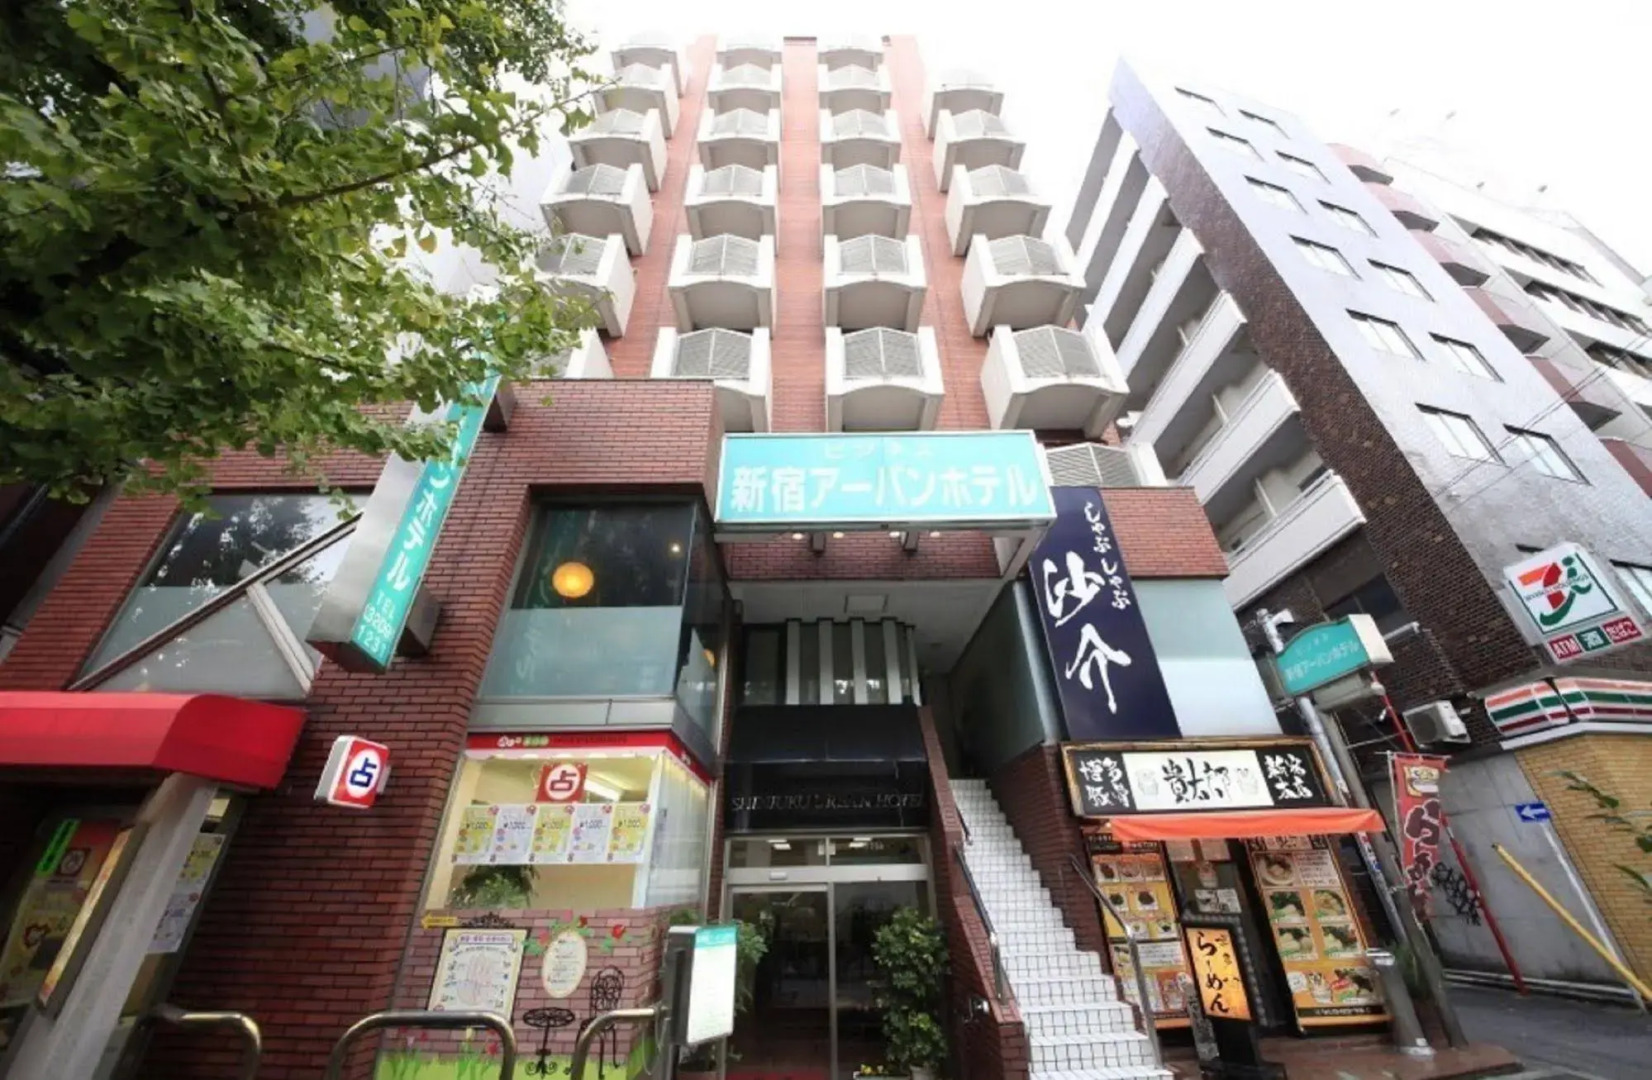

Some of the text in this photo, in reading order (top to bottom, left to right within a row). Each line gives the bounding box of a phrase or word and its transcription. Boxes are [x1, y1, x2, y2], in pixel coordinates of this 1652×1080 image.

[730, 464, 1039, 513] 新宿アーバンホテル
[1551, 637, 1582, 658] ATM
[350, 757, 377, 788] 占
[550, 769, 577, 792] 占
[1197, 930, 1231, 1014] らーめん
